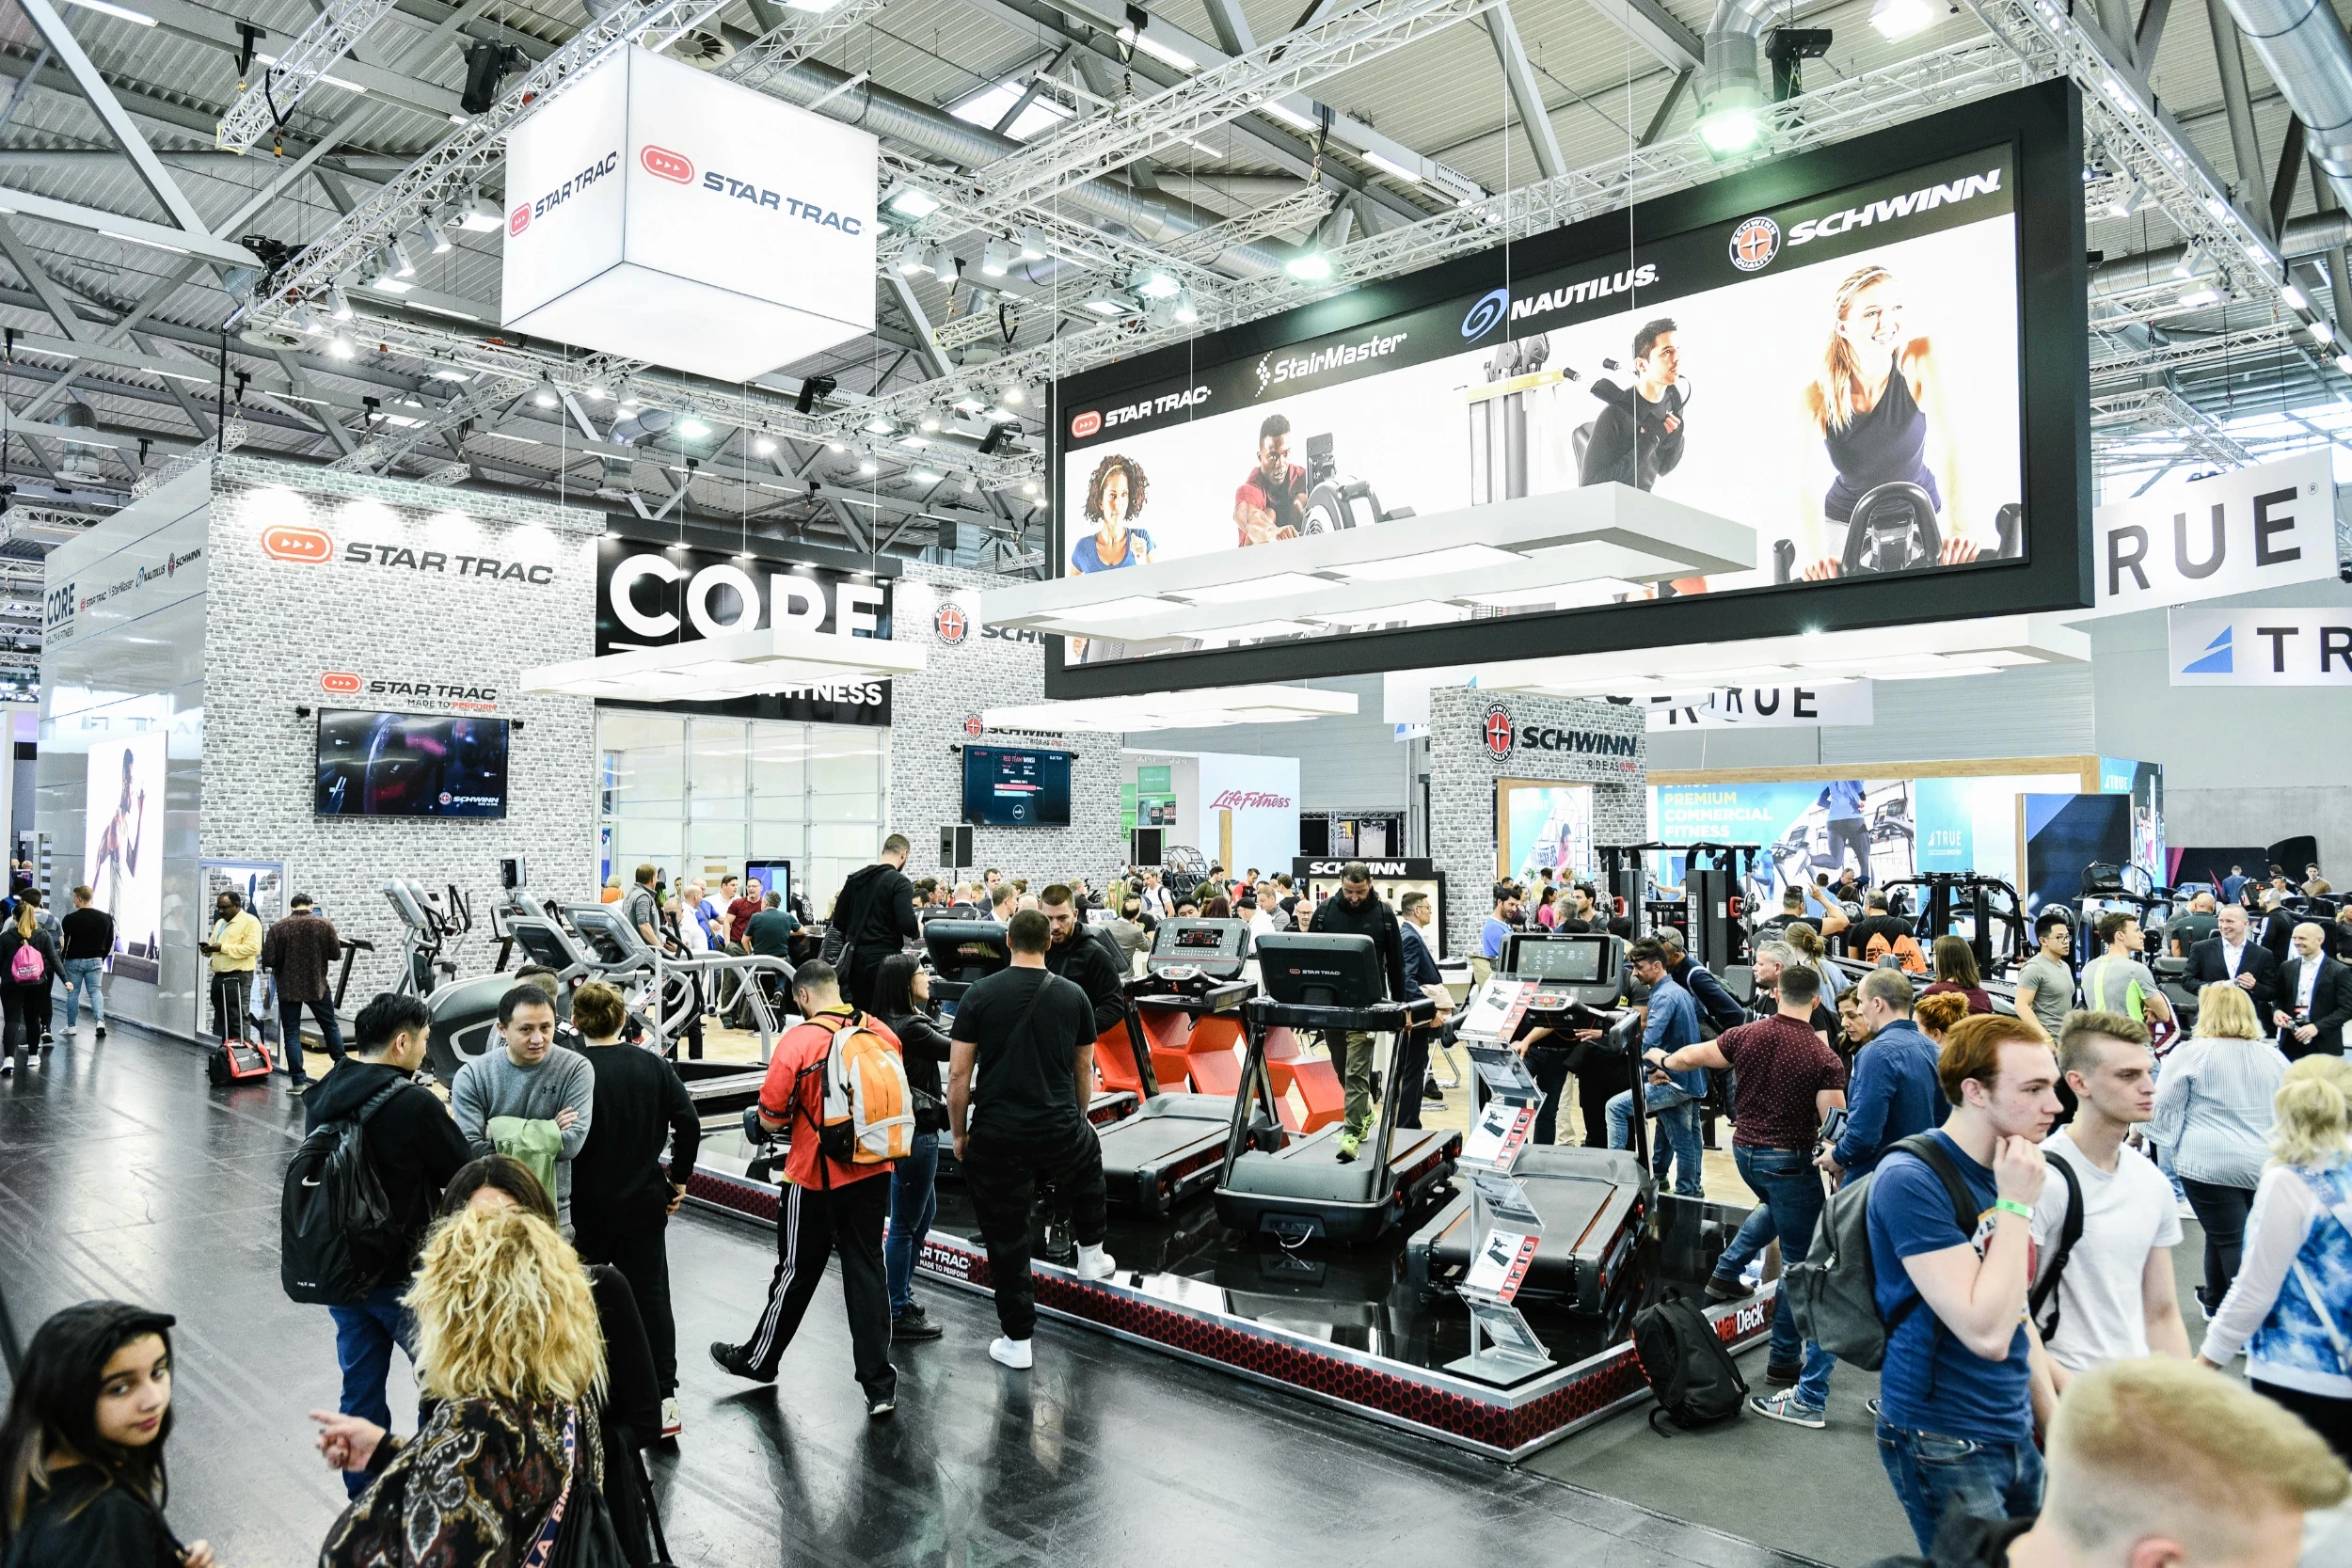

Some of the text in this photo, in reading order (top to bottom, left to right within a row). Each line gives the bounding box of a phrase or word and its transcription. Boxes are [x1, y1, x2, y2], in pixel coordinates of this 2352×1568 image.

[534, 151, 617, 219] STAR TRAC
[703, 171, 862, 235] STAR TRAC
[1788, 168, 2001, 246] SCHWINN
[1732, 219, 1777, 245] SCHWINN
[1735, 249, 1774, 269] QUALITY
[1510, 264, 1656, 321] NAUTILUS
[1274, 335, 1403, 383] StairMaster
[1104, 387, 1207, 428] STAR TRAC
[175, 547, 202, 568] SCHWINN
[344, 542, 553, 585] STAR TRAC
[144, 564, 166, 582] NAUTILUS
[47, 583, 75, 626] CORE
[610, 553, 884, 640] CORE
[369, 680, 497, 701] STAR TRAC
[407, 699, 435, 707] MADE
[453, 702, 498, 711] PERFORM
[1484, 703, 1515, 729] SCHWINN
[1521, 726, 1637, 756] SCHWINN
[1485, 743, 1512, 763] QUALITY
[1588, 759, 1637, 772] RIDE AS ONE
[2109, 775, 2128, 791] TRUE
[1664, 792, 1737, 805] PREMIUM
[1664, 808, 1773, 822] COMMERCIAL
[1664, 825, 1730, 838] FITNESS
[1935, 831, 1962, 847] TRUE
[1309, 861, 1406, 876] SCHINN
[919, 1259, 968, 1280] MADE TO PERFORM
[934, 1249, 968, 1270] TRAC
